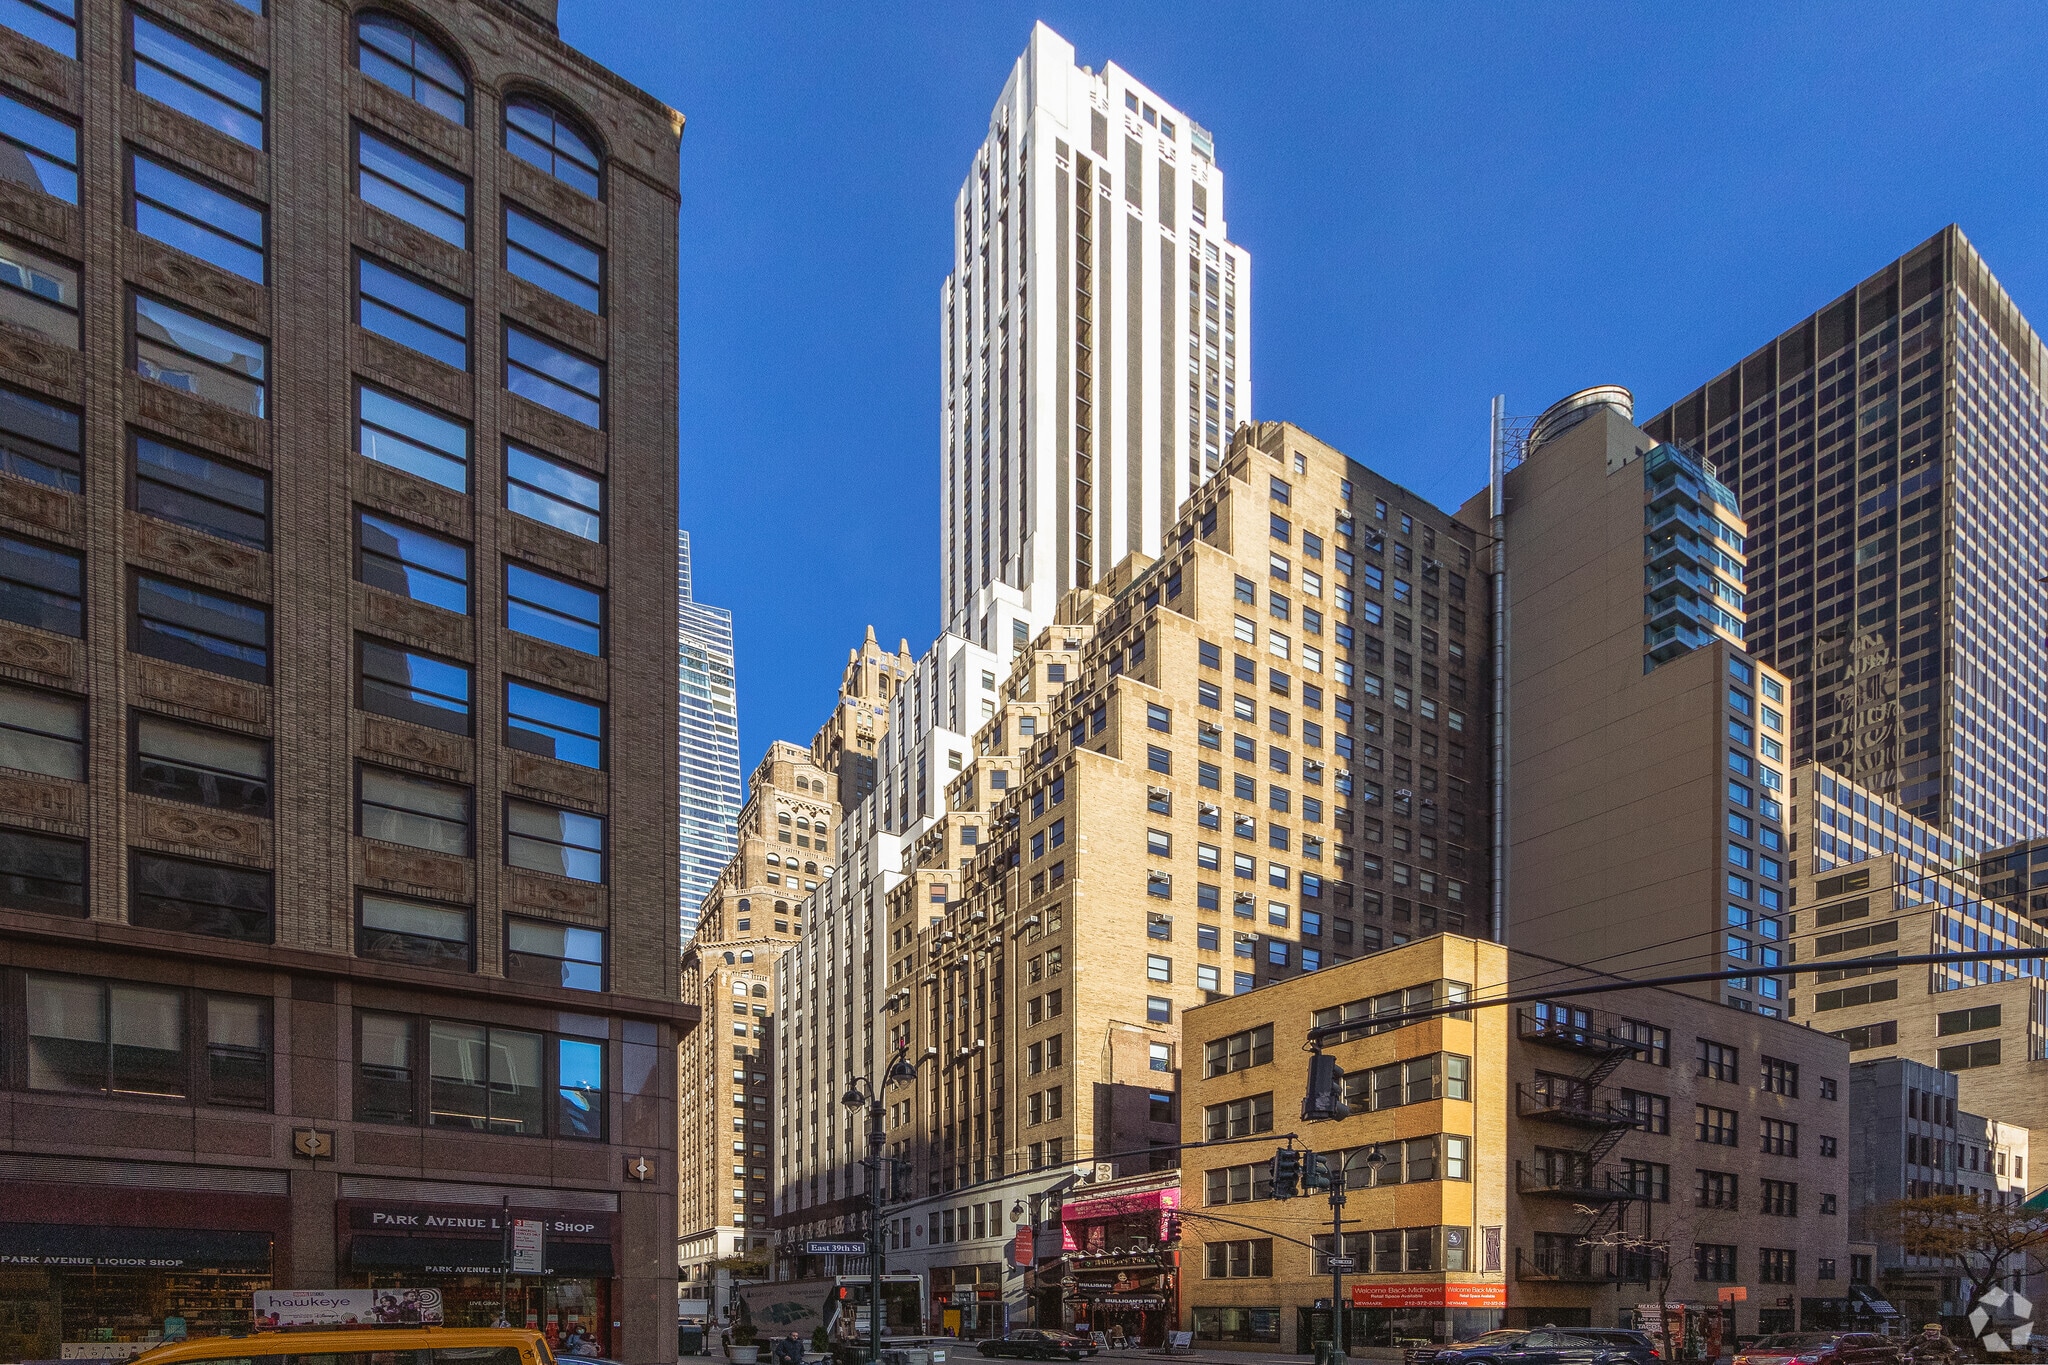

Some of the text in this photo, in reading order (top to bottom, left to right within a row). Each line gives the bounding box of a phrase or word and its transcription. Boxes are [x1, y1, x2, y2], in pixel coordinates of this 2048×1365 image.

[372, 1212, 419, 1225] PARK
[425, 1216, 486, 1228] AVENUE
[554, 1221, 594, 1233] SHOP
[270, 1296, 350, 1308] hawkeye
